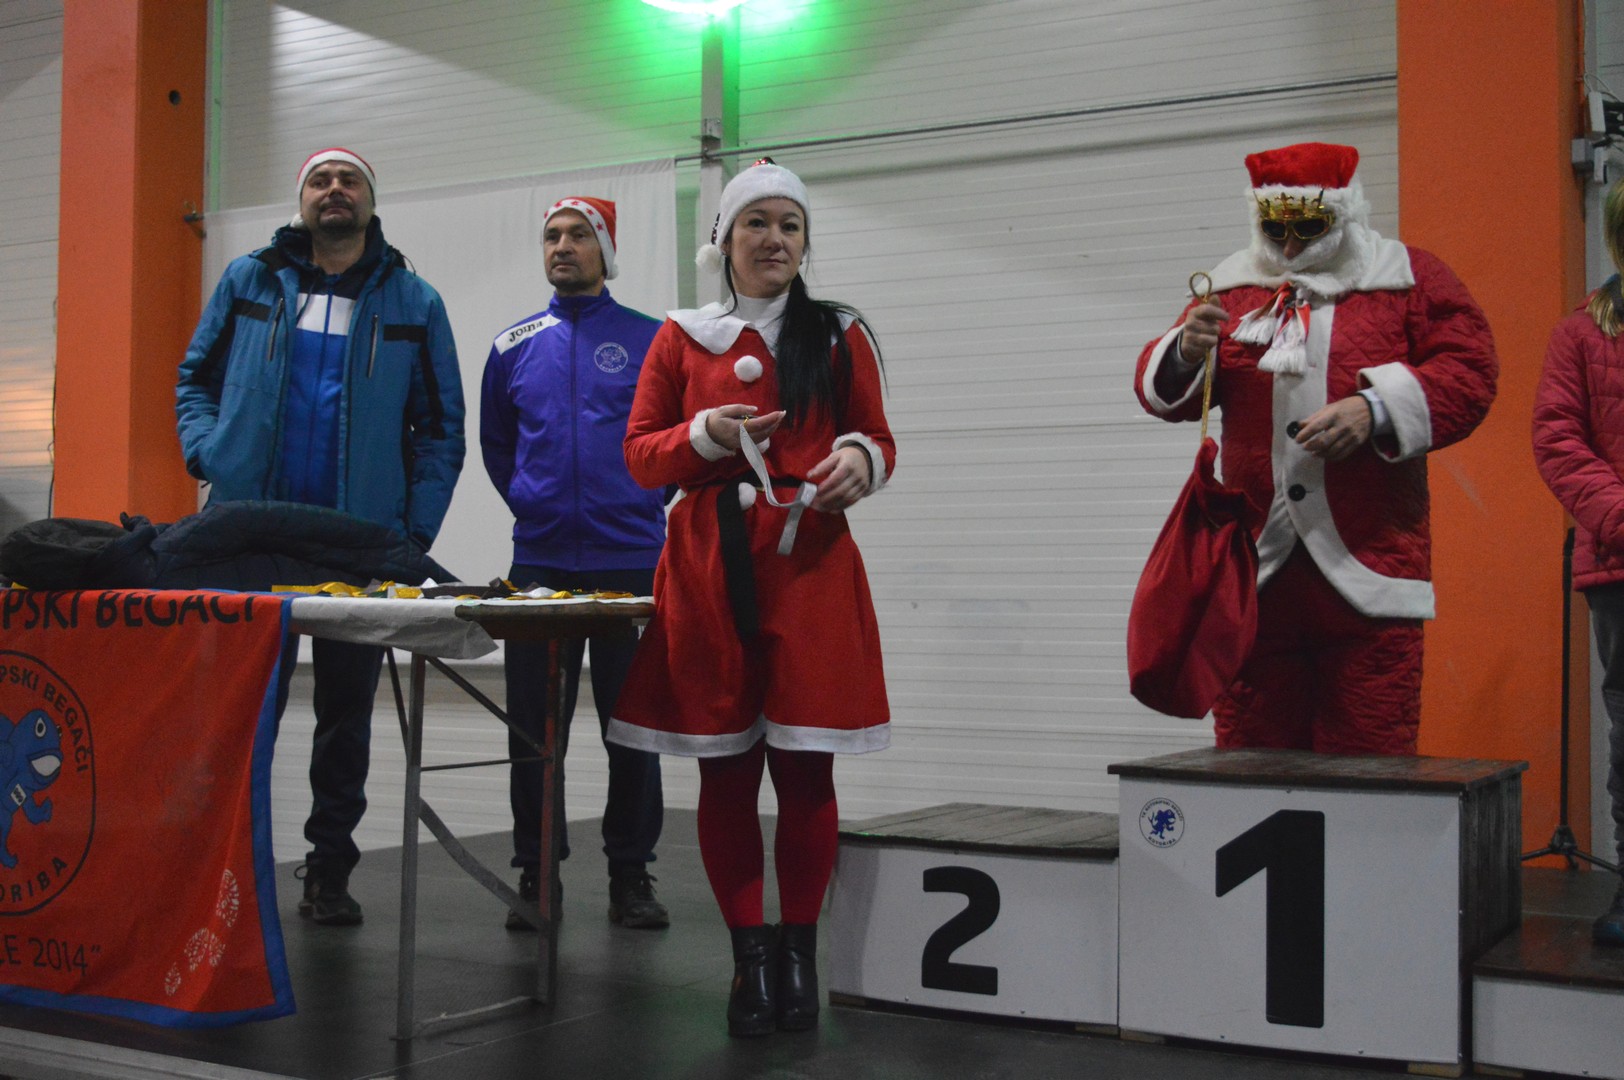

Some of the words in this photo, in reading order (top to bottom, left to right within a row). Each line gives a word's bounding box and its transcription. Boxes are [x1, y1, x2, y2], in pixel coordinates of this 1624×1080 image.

[0, 934, 21, 964] E
[921, 865, 1000, 996] 2
[1215, 809, 1325, 1029] 1
